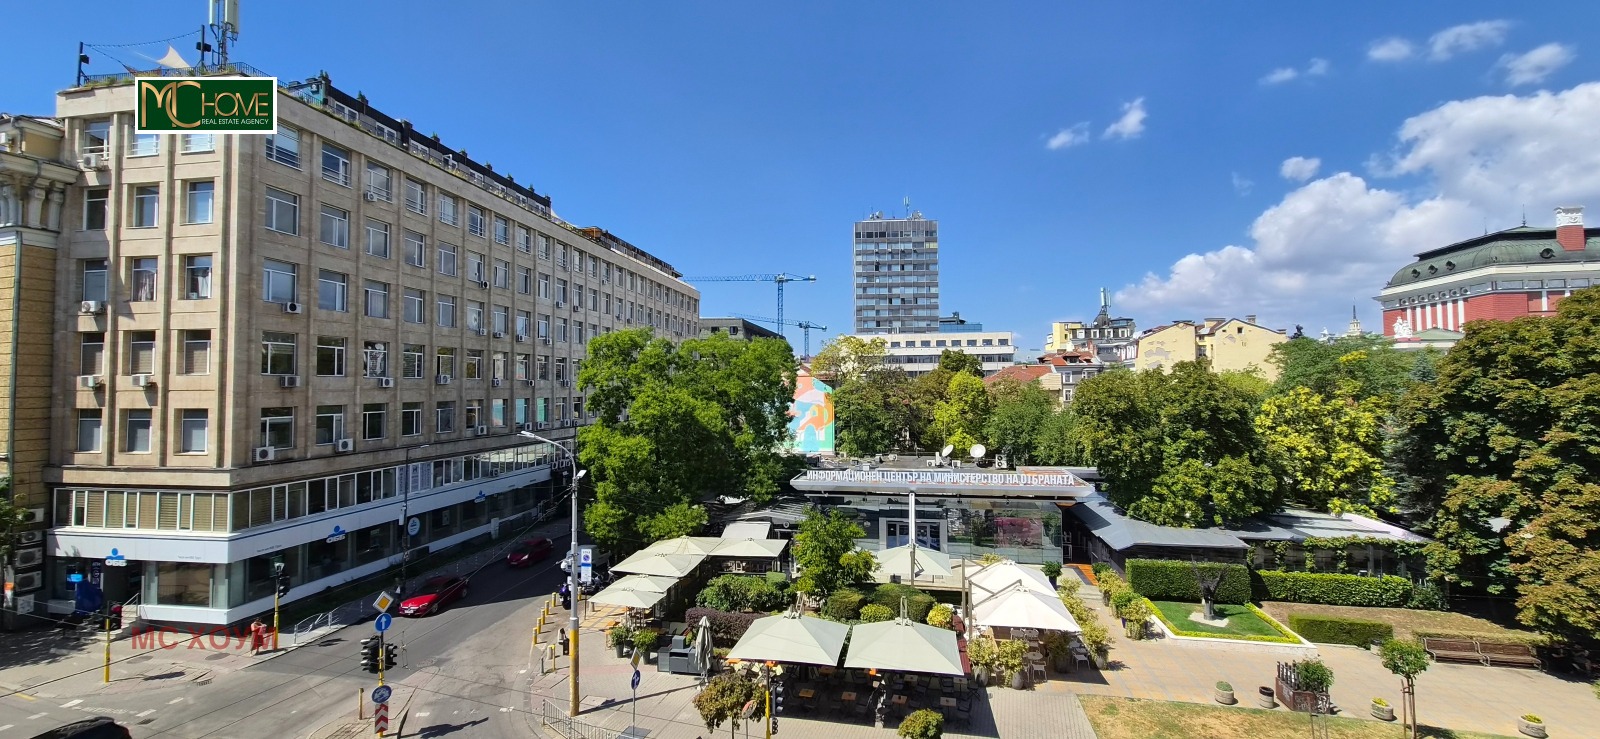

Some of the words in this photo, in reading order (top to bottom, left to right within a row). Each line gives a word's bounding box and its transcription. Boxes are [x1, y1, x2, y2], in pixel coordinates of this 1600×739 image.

[807, 470, 881, 482] ИНФОРМАЦИОНЕН
[884, 472, 918, 483] ЦЕНТЪР
[921, 473, 932, 482] НА
[934, 472, 1004, 484] МИНИСТЕРСТВО
[1006, 474, 1018, 484] НА
[1020, 474, 1075, 485] ОТБРАНАТА
